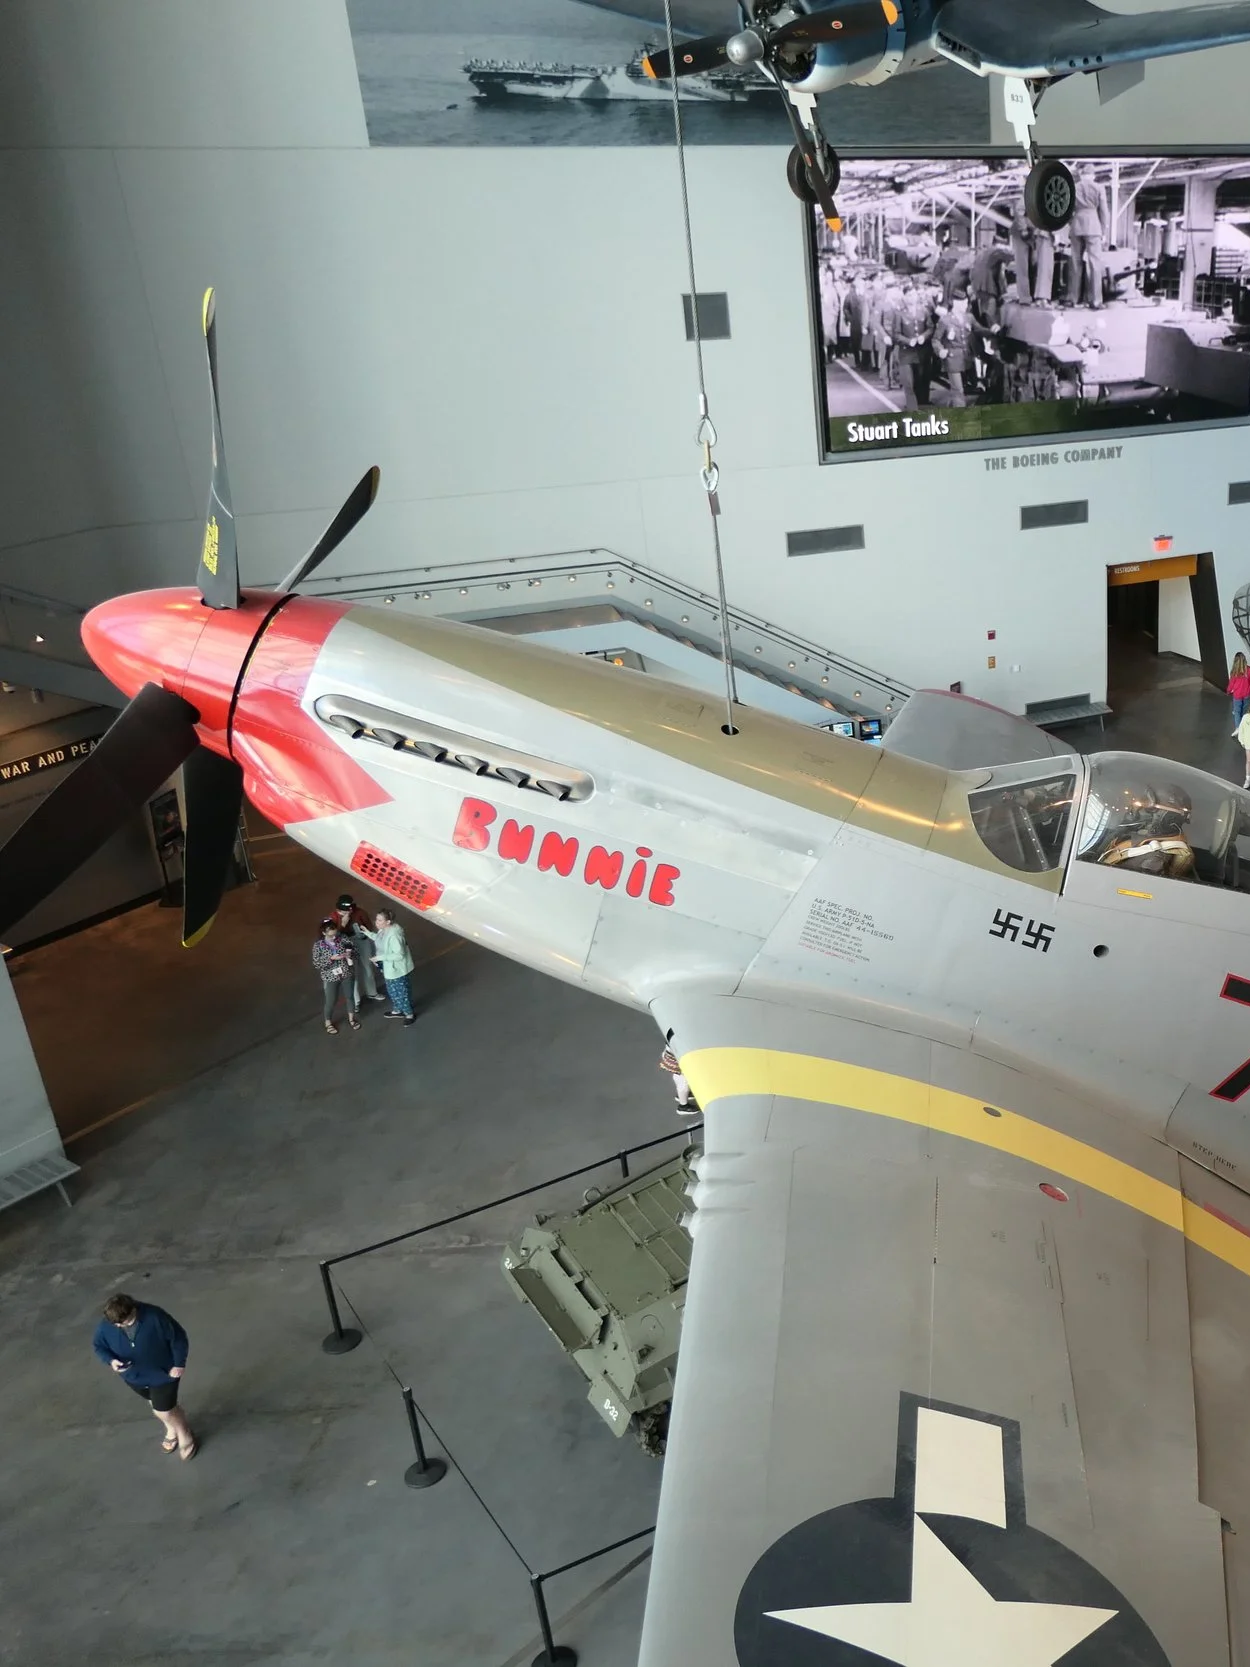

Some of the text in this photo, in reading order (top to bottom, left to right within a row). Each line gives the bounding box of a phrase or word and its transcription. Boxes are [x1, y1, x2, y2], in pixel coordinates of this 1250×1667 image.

[847, 414, 950, 443] Stuart Tanks
[984, 446, 1124, 471] THE BOEING COMPANY
[1114, 564, 1140, 575] RESTROOMS
[0, 738, 103, 779] WAR AND PEA
[809, 908, 829, 920] SERIAL
[824, 908, 841, 917] ARMY
